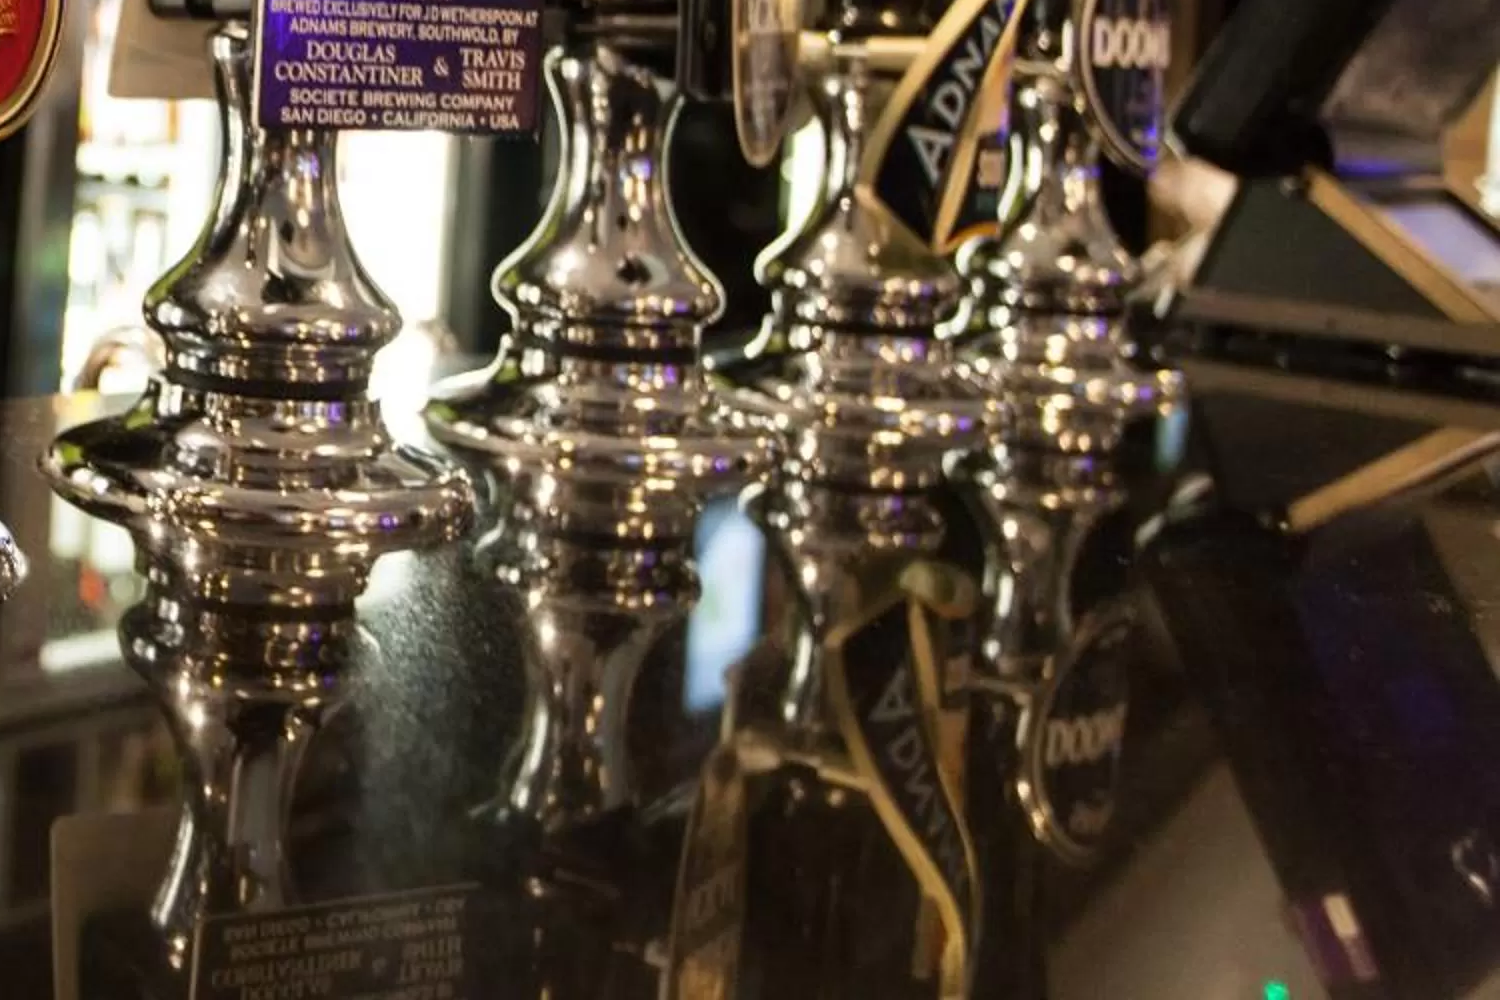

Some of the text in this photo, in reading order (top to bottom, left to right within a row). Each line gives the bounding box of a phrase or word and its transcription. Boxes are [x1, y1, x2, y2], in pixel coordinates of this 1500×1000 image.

[323, 0, 398, 19] EXCLUSIVELY
[400, 3, 422, 20] FOR
[441, 6, 524, 26] WETHERSPOON
[526, 11, 539, 29] AT
[290, 17, 347, 35] ADNAMS
[502, 29, 519, 47] BY
[307, 40, 397, 65] DOUGLAS
[459, 47, 526, 71] TRAVIS
[275, 60, 424, 87] CONSTANTINER
[433, 56, 450, 77] &
[462, 69, 522, 91] SMITH
[290, 88, 515, 113] SOCIETE BREWING COMPANY
[281, 106, 520, 130] SAN DIEGO CALIFORNIA USA
